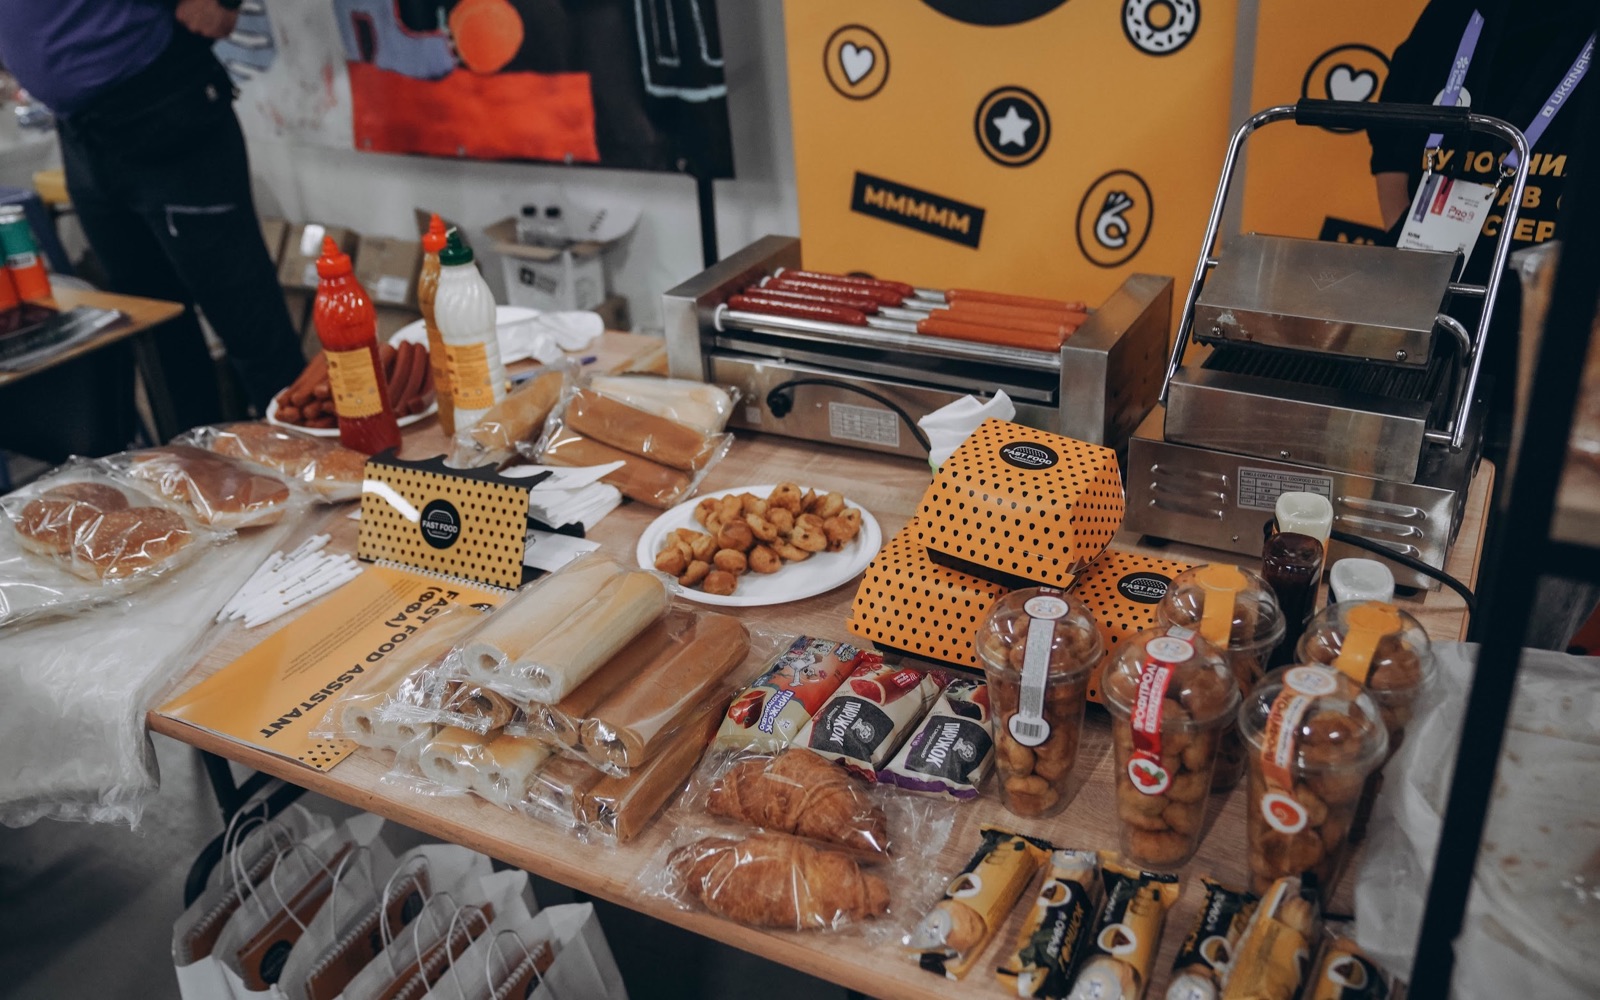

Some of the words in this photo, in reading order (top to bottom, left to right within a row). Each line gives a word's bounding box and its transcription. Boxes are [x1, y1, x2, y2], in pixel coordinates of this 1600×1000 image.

[864, 184, 971, 234] MMMMM
[1003, 448, 1027, 458] FAST
[1027, 455, 1052, 465] FOOD
[422, 519, 438, 530] FAST
[439, 522, 458, 534] FOOD
[385, 586, 443, 628] (ФФА)
[416, 590, 460, 624] FAST
[1121, 582, 1146, 591] FAST
[1146, 587, 1167, 595] FOO
[366, 624, 419, 663] FOOD
[259, 663, 365, 739] ASSISTANT
[765, 690, 794, 734] ПИРІЖОК
[829, 701, 861, 747] ПИРІЖОК
[926, 722, 960, 768] ПИРІЖОК
